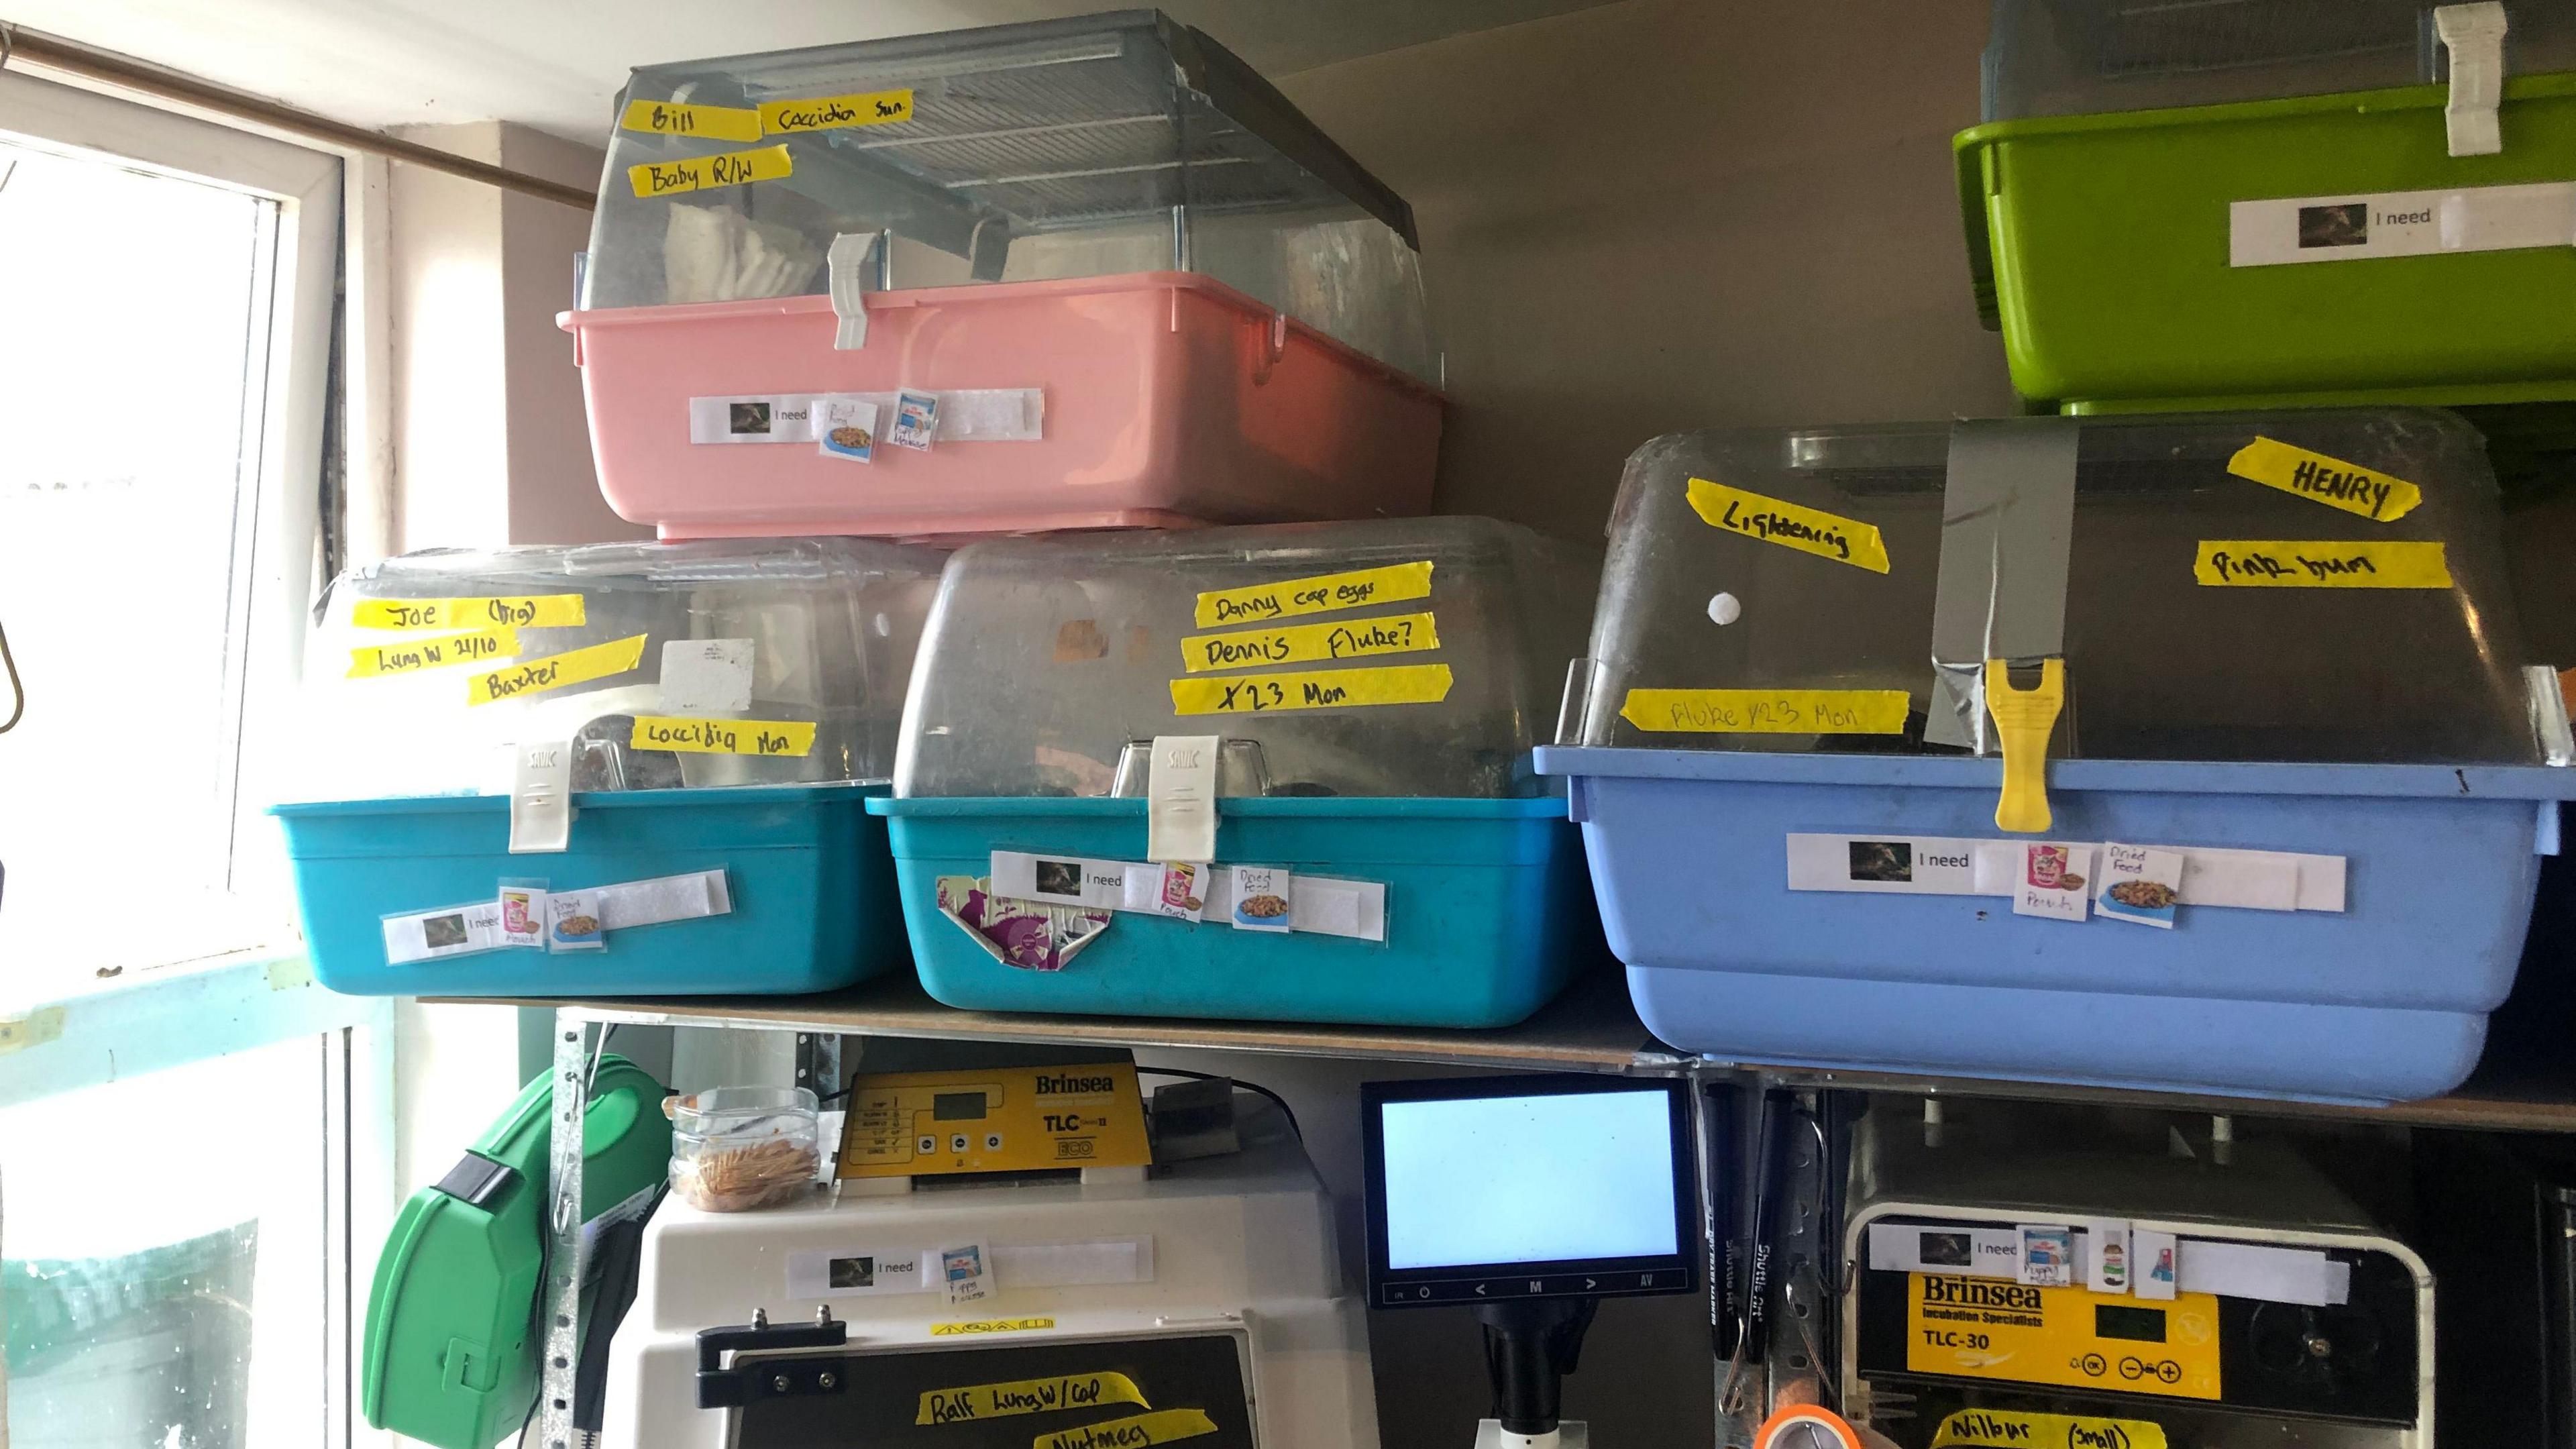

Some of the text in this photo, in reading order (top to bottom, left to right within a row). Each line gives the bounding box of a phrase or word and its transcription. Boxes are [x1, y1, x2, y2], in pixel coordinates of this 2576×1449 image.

[652, 105, 694, 132] Bill
[651, 156, 753, 192] Baby R/W
[2376, 208, 2431, 225] I need
[775, 408, 807, 420] I need
[2292, 460, 2392, 518] HENRY
[1216, 581, 1375, 621] Danny cap eggs
[386, 606, 436, 627] Joe
[1205, 621, 1413, 665] Dennis Fluke?
[487, 661, 559, 699] Baxter
[1303, 682, 1346, 705] Mon
[1815, 703, 1858, 727] Mon
[1168, 750, 1199, 769] SAVIC
[1919, 853, 1969, 868] I need
[2110, 846, 2146, 861] Dried
[2114, 859, 2143, 874] Food
[1086, 873, 1122, 887] I need
[1160, 902, 1187, 919] Pouch
[469, 919, 473, 929] I
[1035, 1074, 1114, 1094] Brinsea
[1043, 1114, 1079, 1132] TLC
[1058, 1141, 1093, 1155] ECO
[1978, 1242, 1981, 1253] I
[879, 1262, 913, 1273] I need
[1754, 1244, 1771, 1293] Shuttle
[1529, 1281, 1542, 1293] M
[1640, 1274, 1654, 1288] AV
[1923, 1275, 2042, 1309] Brinsea
[1923, 1307, 2043, 1327] Incubation Specialists
[1923, 1330, 1990, 1350] TLC-30
[931, 1391, 975, 1424] Ralf
